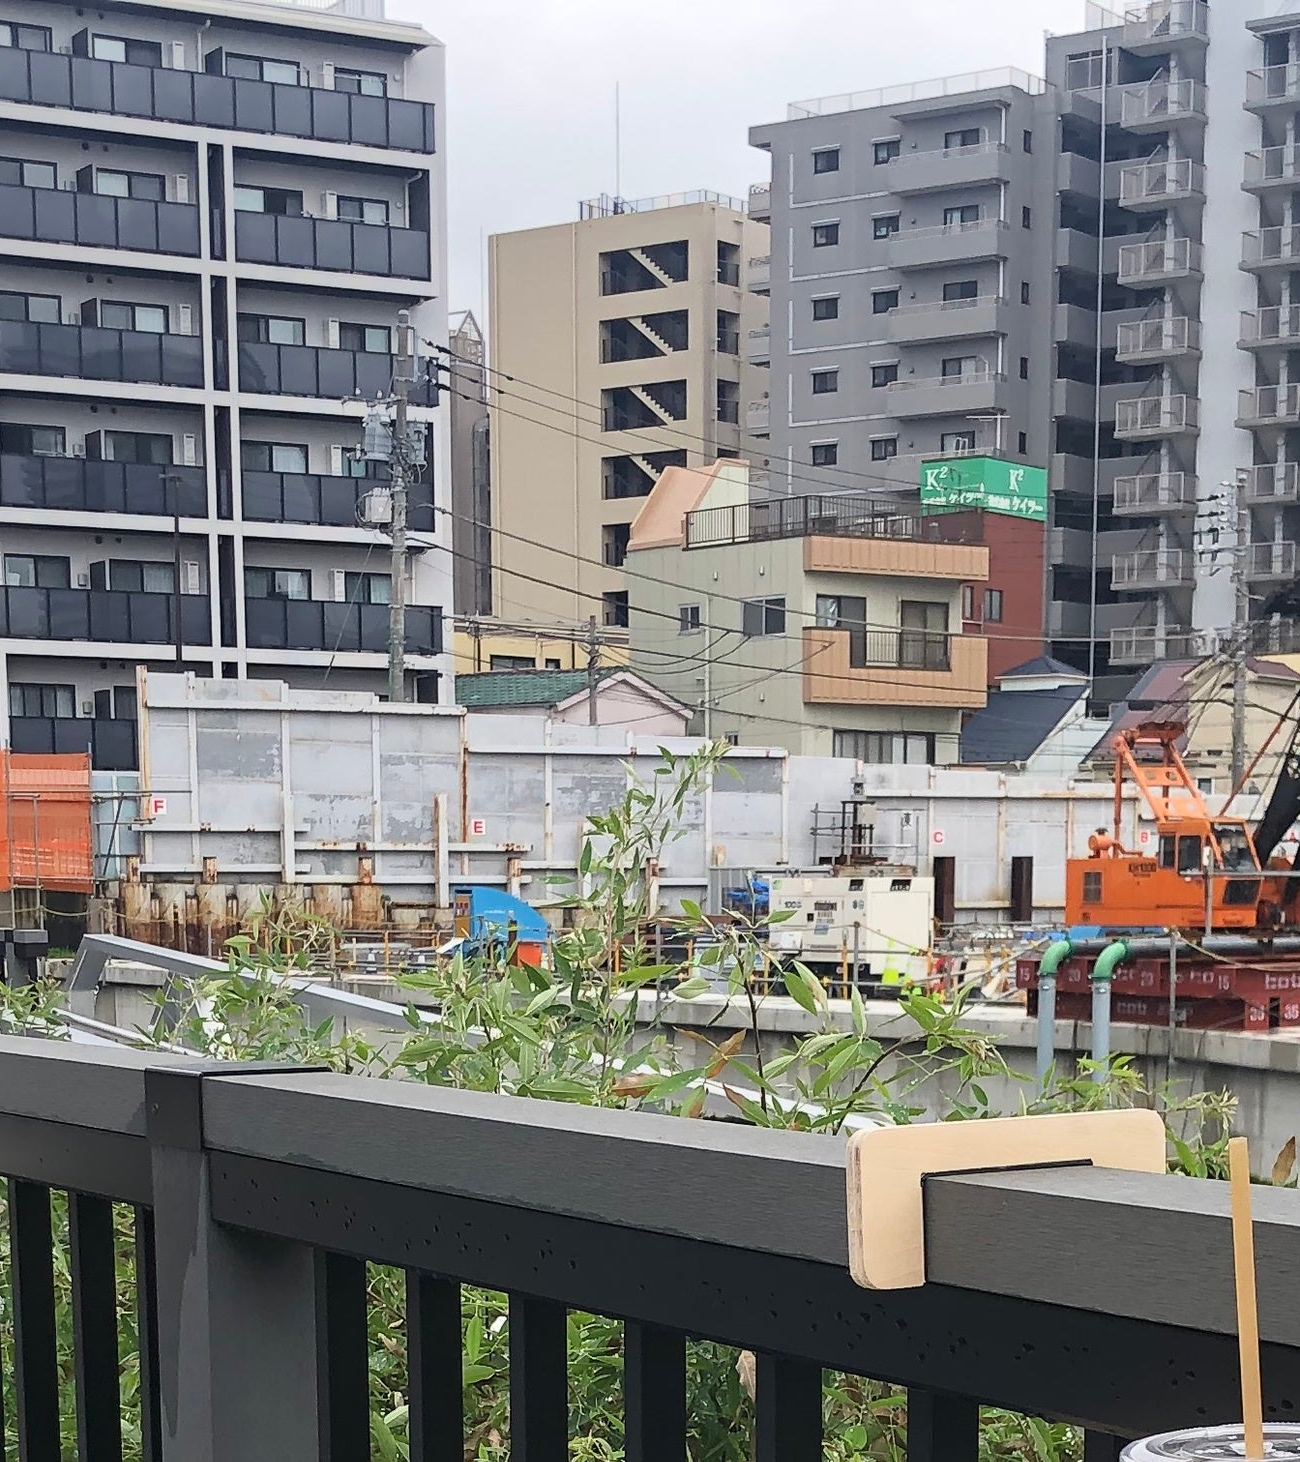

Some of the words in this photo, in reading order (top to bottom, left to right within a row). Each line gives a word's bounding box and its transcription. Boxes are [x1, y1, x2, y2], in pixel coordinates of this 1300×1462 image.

[153, 799, 164, 813] F
[473, 821, 483, 834] E
[933, 831, 943, 843] C
